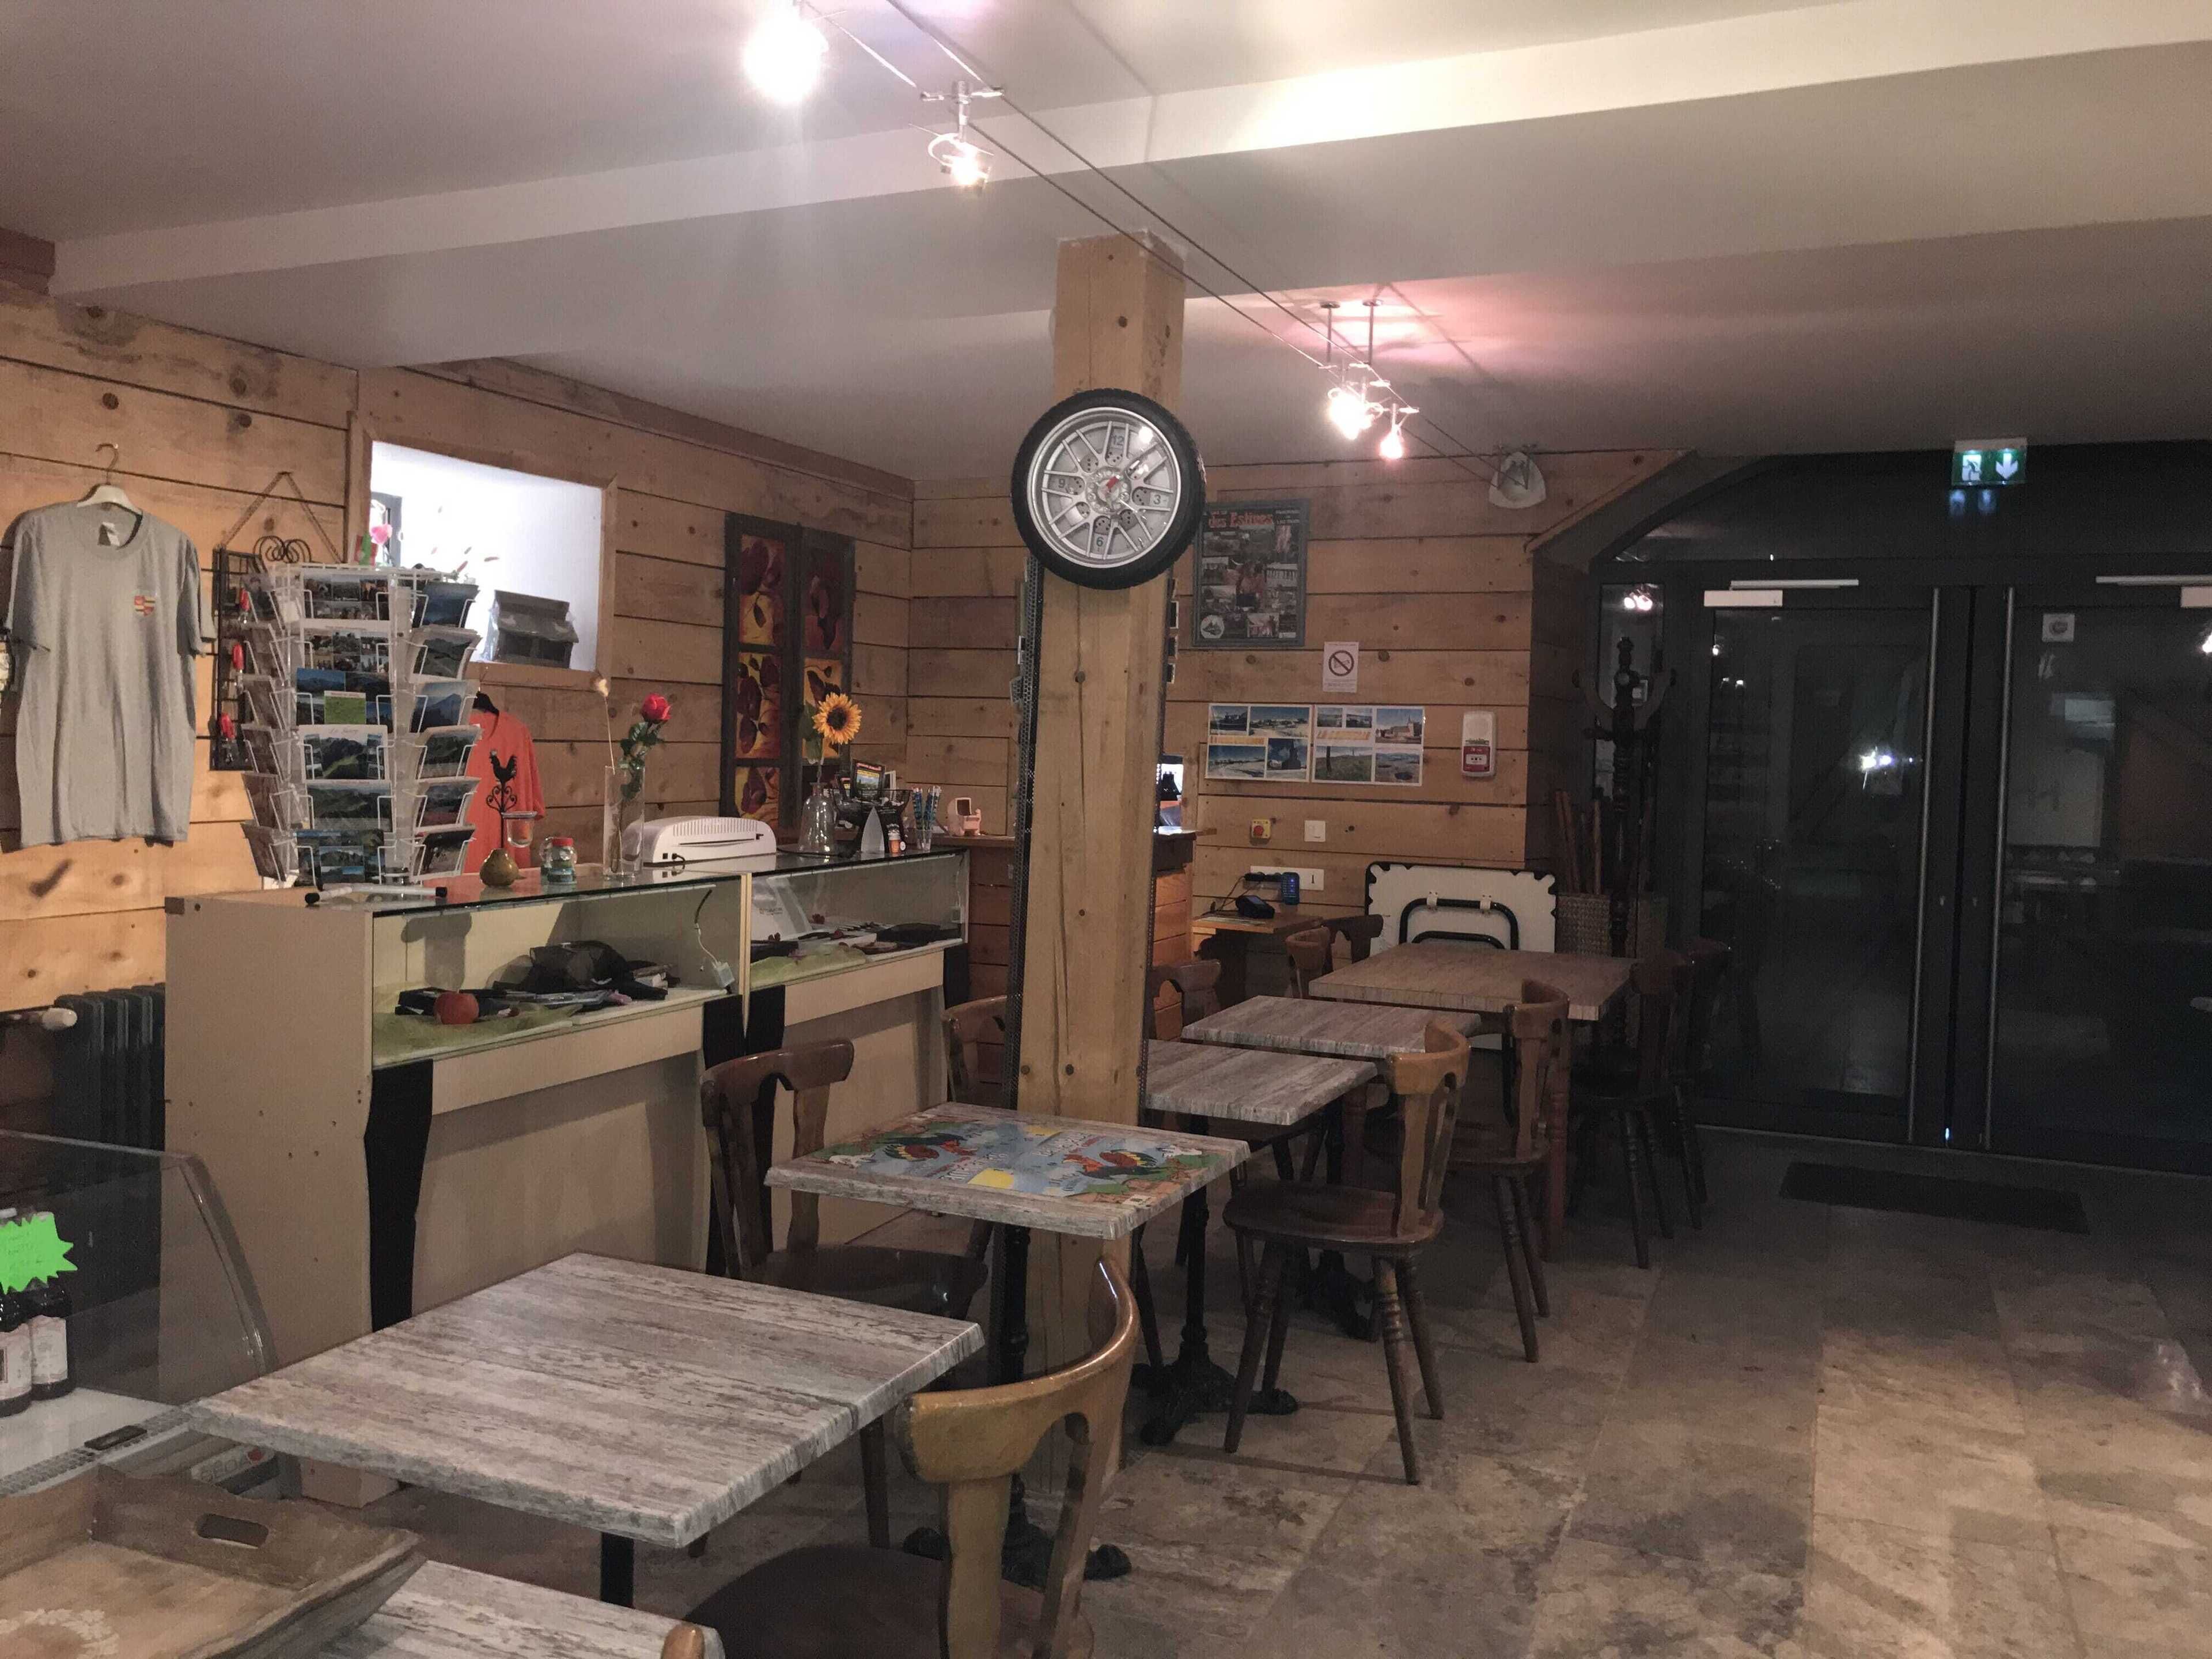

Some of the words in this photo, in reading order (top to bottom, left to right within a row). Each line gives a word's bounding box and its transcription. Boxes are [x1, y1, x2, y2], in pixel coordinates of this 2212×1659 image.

[1112, 435, 1125, 446] 12
[1058, 479, 1066, 488] 9
[1153, 495, 1161, 505] 3
[1096, 537, 1104, 546] 6
